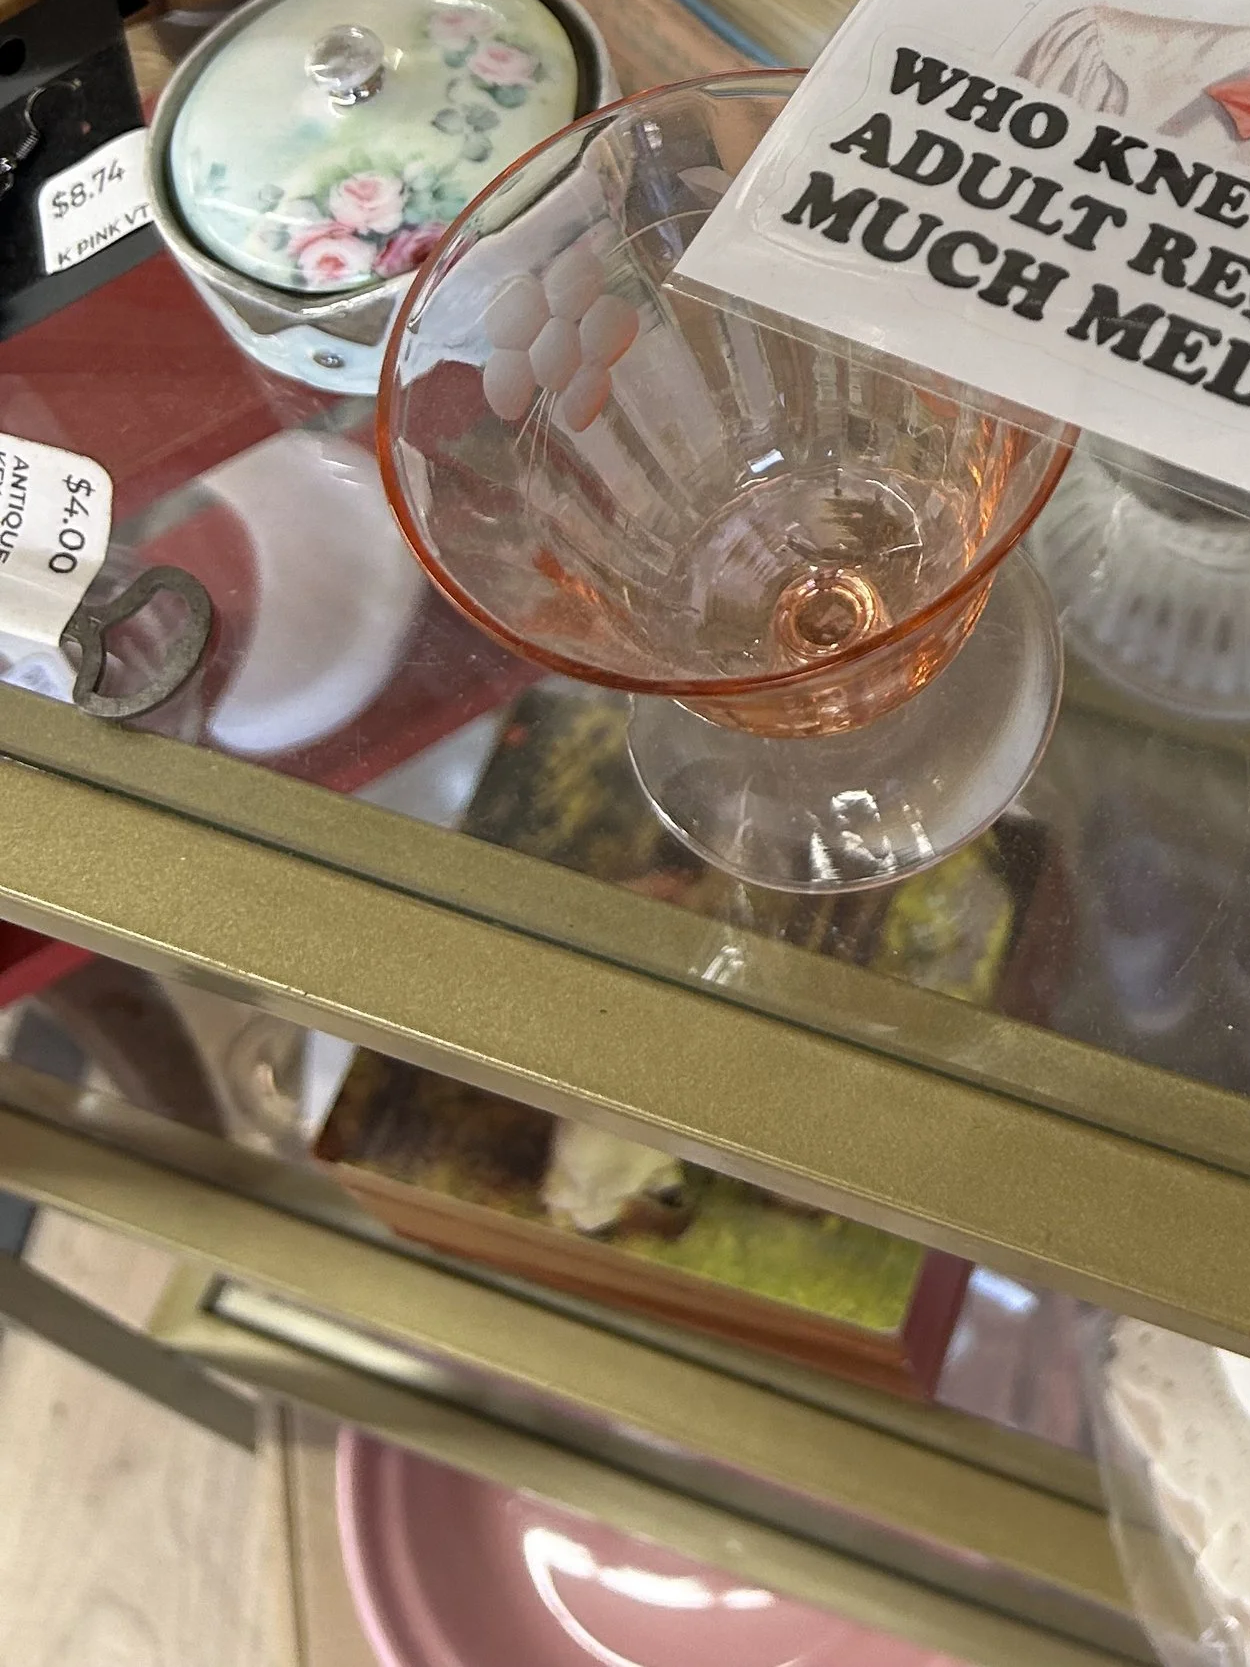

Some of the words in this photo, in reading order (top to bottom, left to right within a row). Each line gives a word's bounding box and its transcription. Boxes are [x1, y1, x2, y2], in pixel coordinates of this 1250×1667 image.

[890, 47, 1069, 149] WHO
[51, 159, 126, 219] $8.74
[830, 112, 1128, 252] ADULT
[781, 170, 1070, 321] MUCH
[48, 474, 96, 574] $4.00
